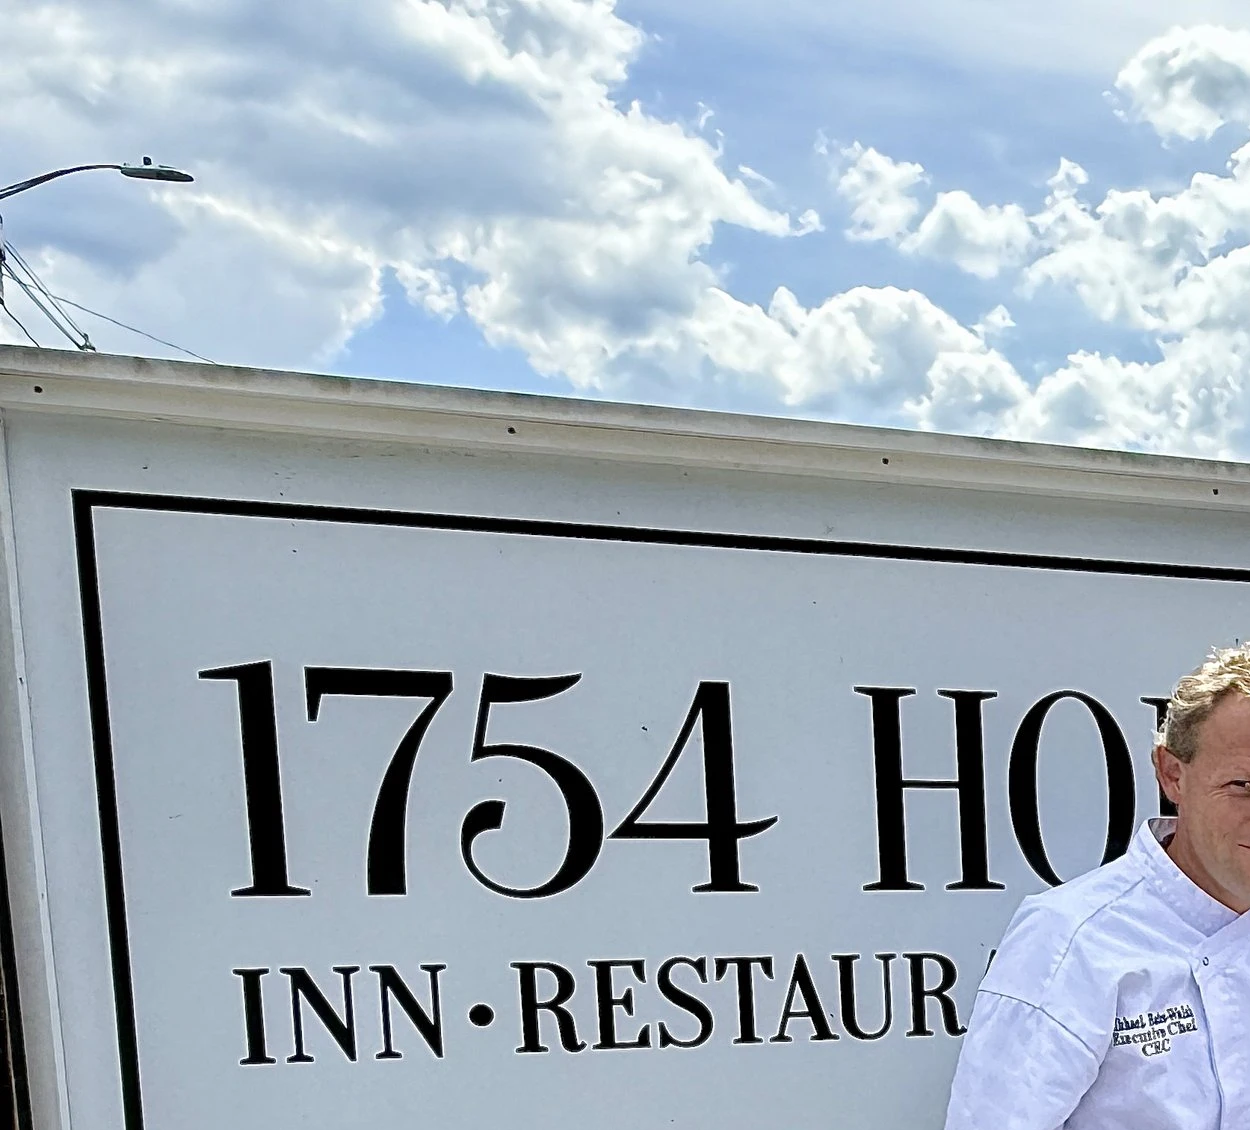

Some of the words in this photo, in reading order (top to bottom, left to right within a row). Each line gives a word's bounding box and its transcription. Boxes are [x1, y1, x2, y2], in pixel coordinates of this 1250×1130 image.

[198, 660, 779, 899] 1754
[232, 964, 447, 1065] INN
[510, 947, 997, 1053] RESTAUR
[1166, 1018, 1198, 1036] Chef
